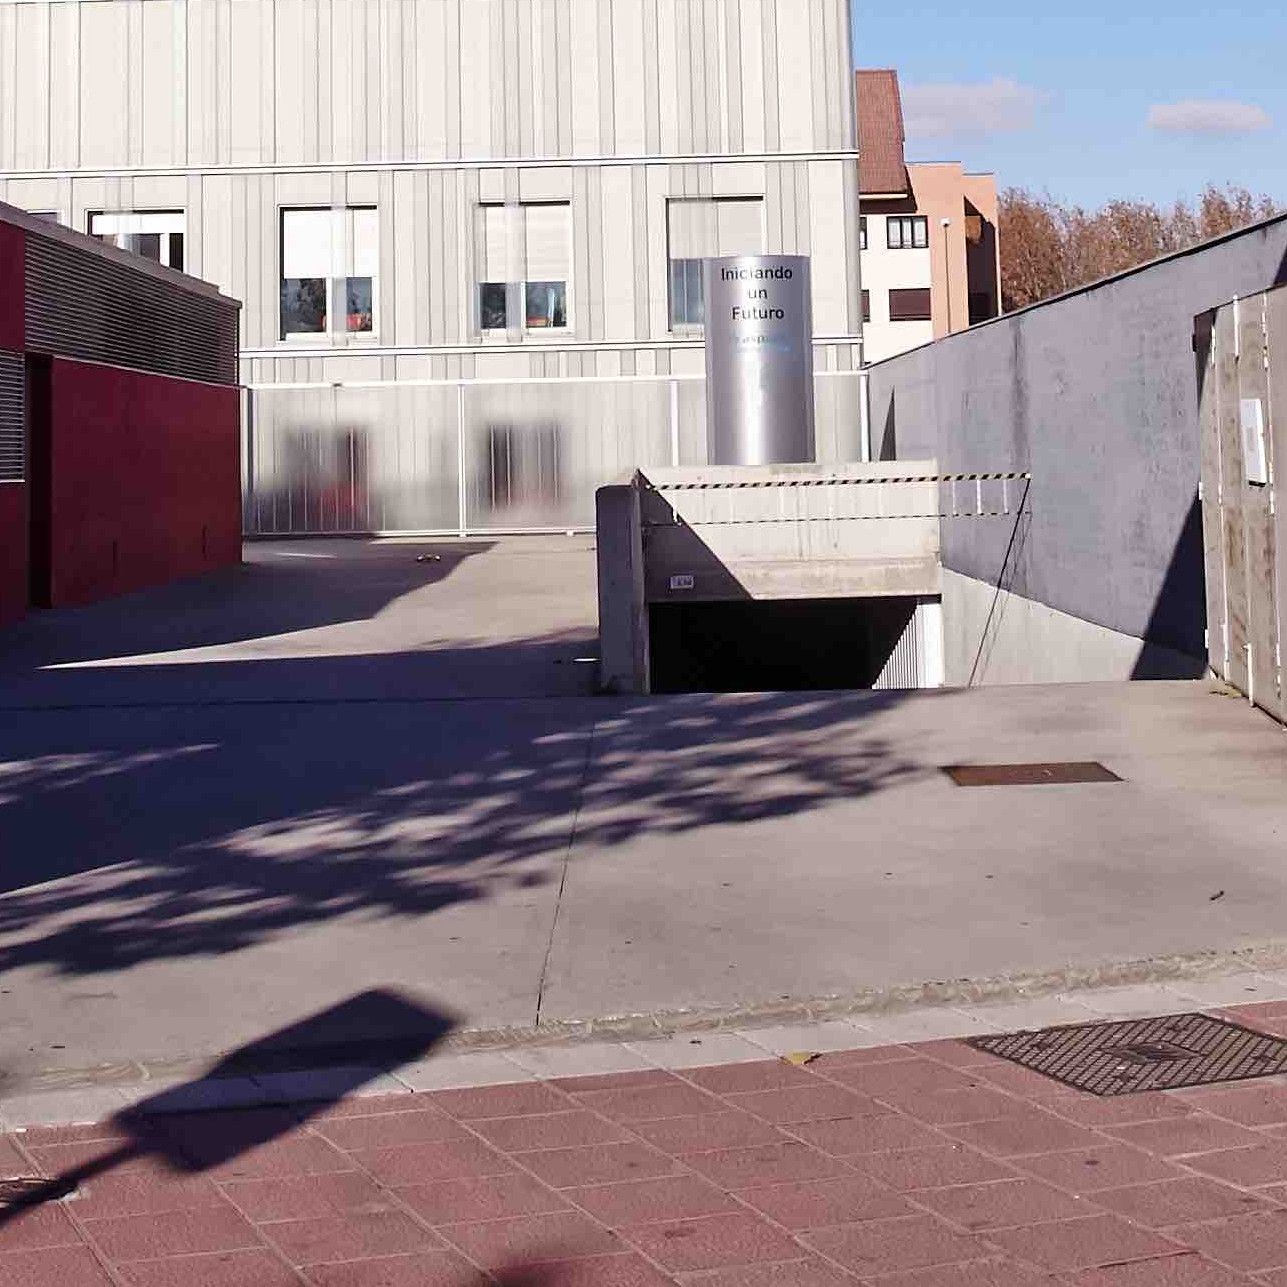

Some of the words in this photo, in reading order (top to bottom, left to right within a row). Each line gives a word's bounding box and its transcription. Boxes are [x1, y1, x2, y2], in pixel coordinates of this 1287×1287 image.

[721, 266, 793, 281] Iniciando
[748, 288, 768, 299] un
[731, 306, 785, 320] Futuro
